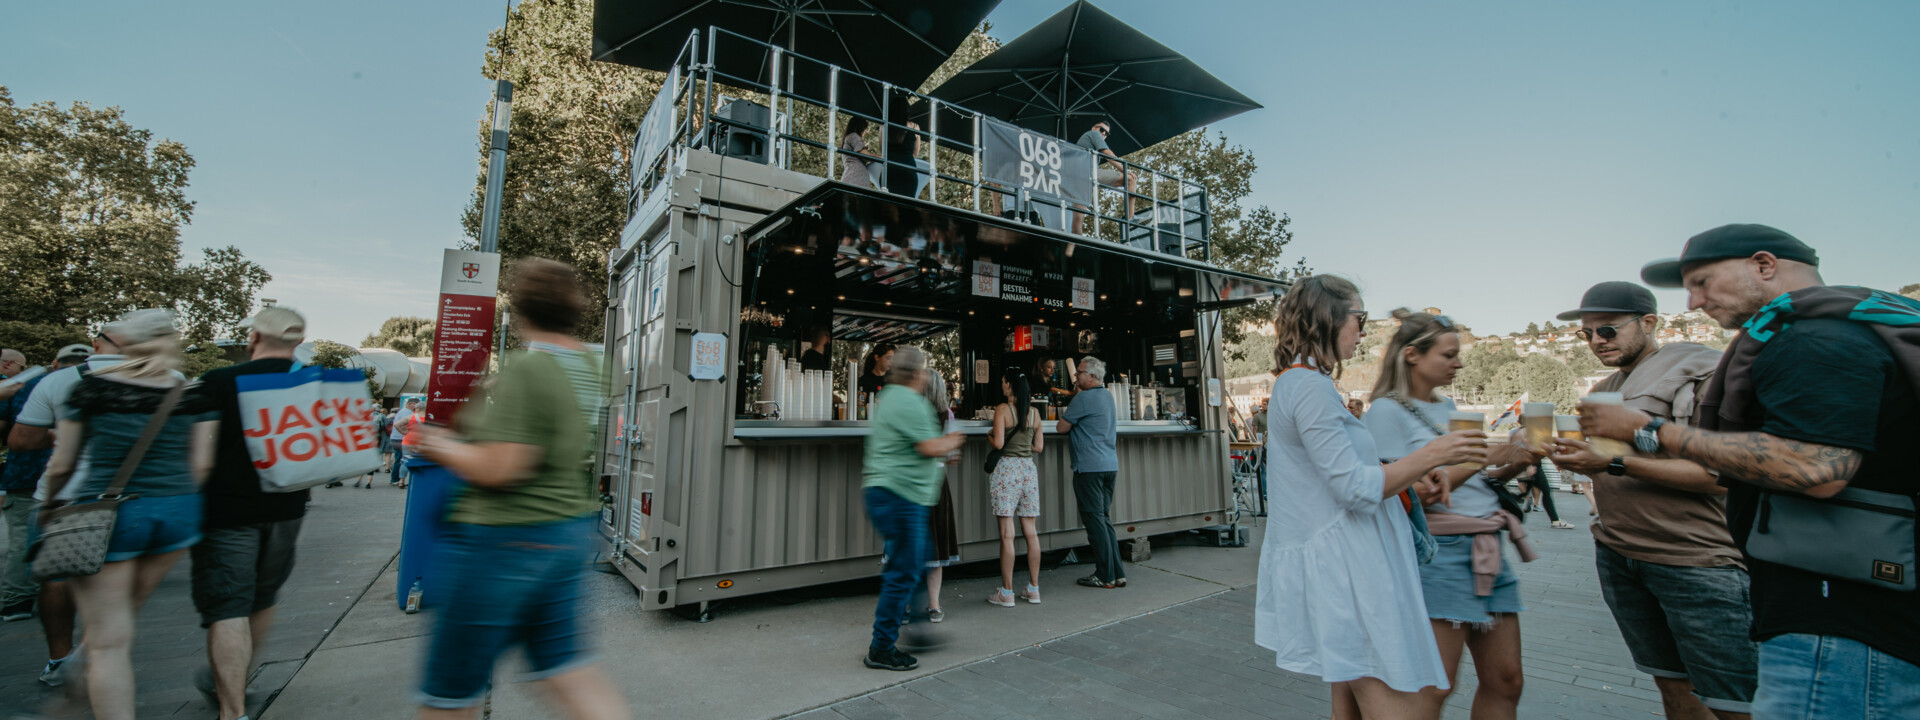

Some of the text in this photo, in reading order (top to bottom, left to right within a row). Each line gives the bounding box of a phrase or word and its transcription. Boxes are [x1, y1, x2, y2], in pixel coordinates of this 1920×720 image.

[1019, 132, 1062, 170] 068
[1020, 160, 1062, 198] BAR
[1003, 284, 1031, 294] BESTELL-
[1002, 293, 1033, 303] ANNAHME
[1044, 298, 1064, 308] KASSE
[696, 340, 720, 355] 068
[696, 354, 720, 366] BAR
